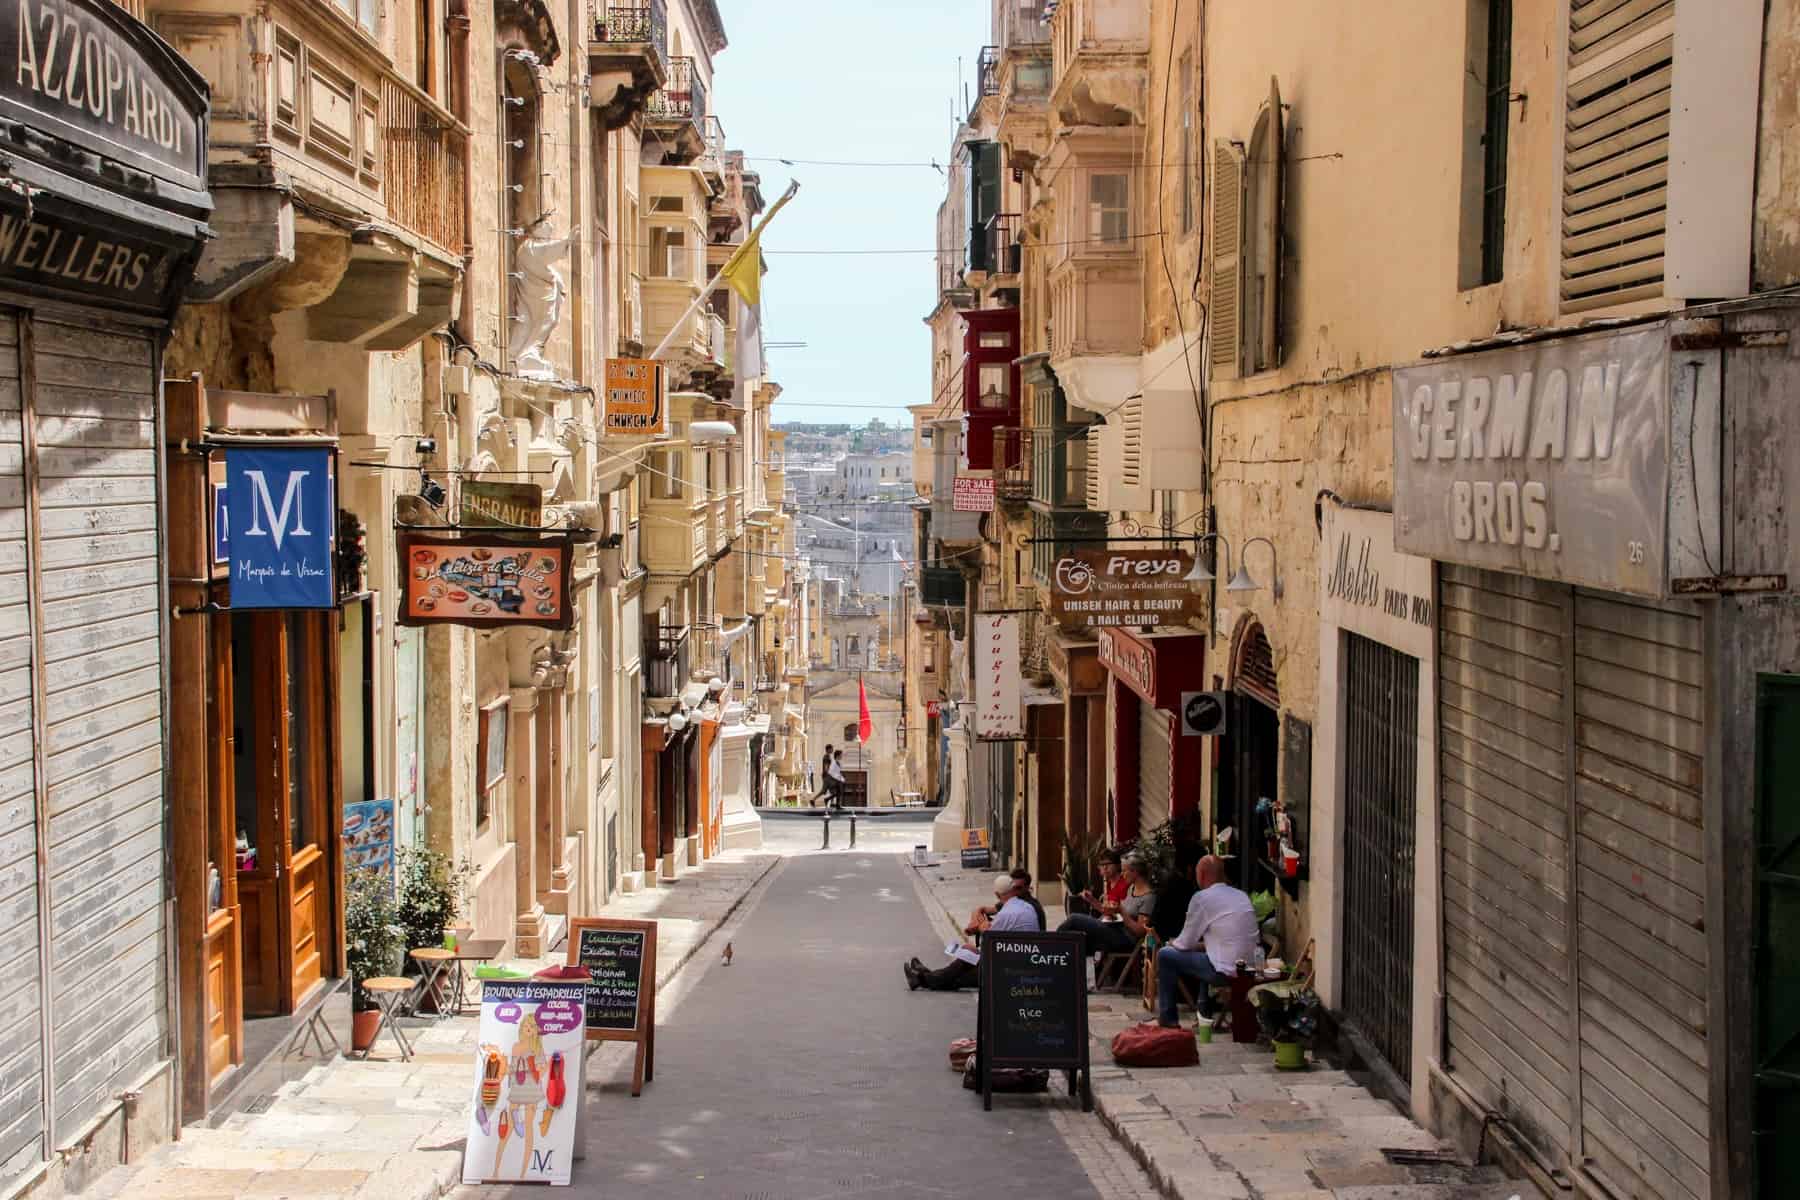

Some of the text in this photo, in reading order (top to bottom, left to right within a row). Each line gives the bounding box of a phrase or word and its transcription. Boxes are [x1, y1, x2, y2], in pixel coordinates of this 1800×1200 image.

[17, 0, 182, 152] AZZOPARDI
[608, 414, 647, 427] CHURCH
[1409, 361, 1621, 461] GERMAN
[954, 479, 993, 489] FOR SALE
[243, 470, 312, 551] M
[1453, 480, 1560, 549] BROS.
[1628, 541, 1643, 563] 26
[281, 561, 293, 576] de
[1106, 556, 1181, 575] Freya
[1063, 599, 1183, 611] UNISEX HAIR & BEAUTY
[1384, 588, 1407, 619] PARIS
[1087, 614, 1160, 626] & NAIL CLINIC
[991, 613, 1003, 711] douglas
[996, 942, 1040, 954] PIADINA
[484, 986, 583, 1000] BOUTIQUE D'ESPADRILLES
[531, 1150, 553, 1174] M
